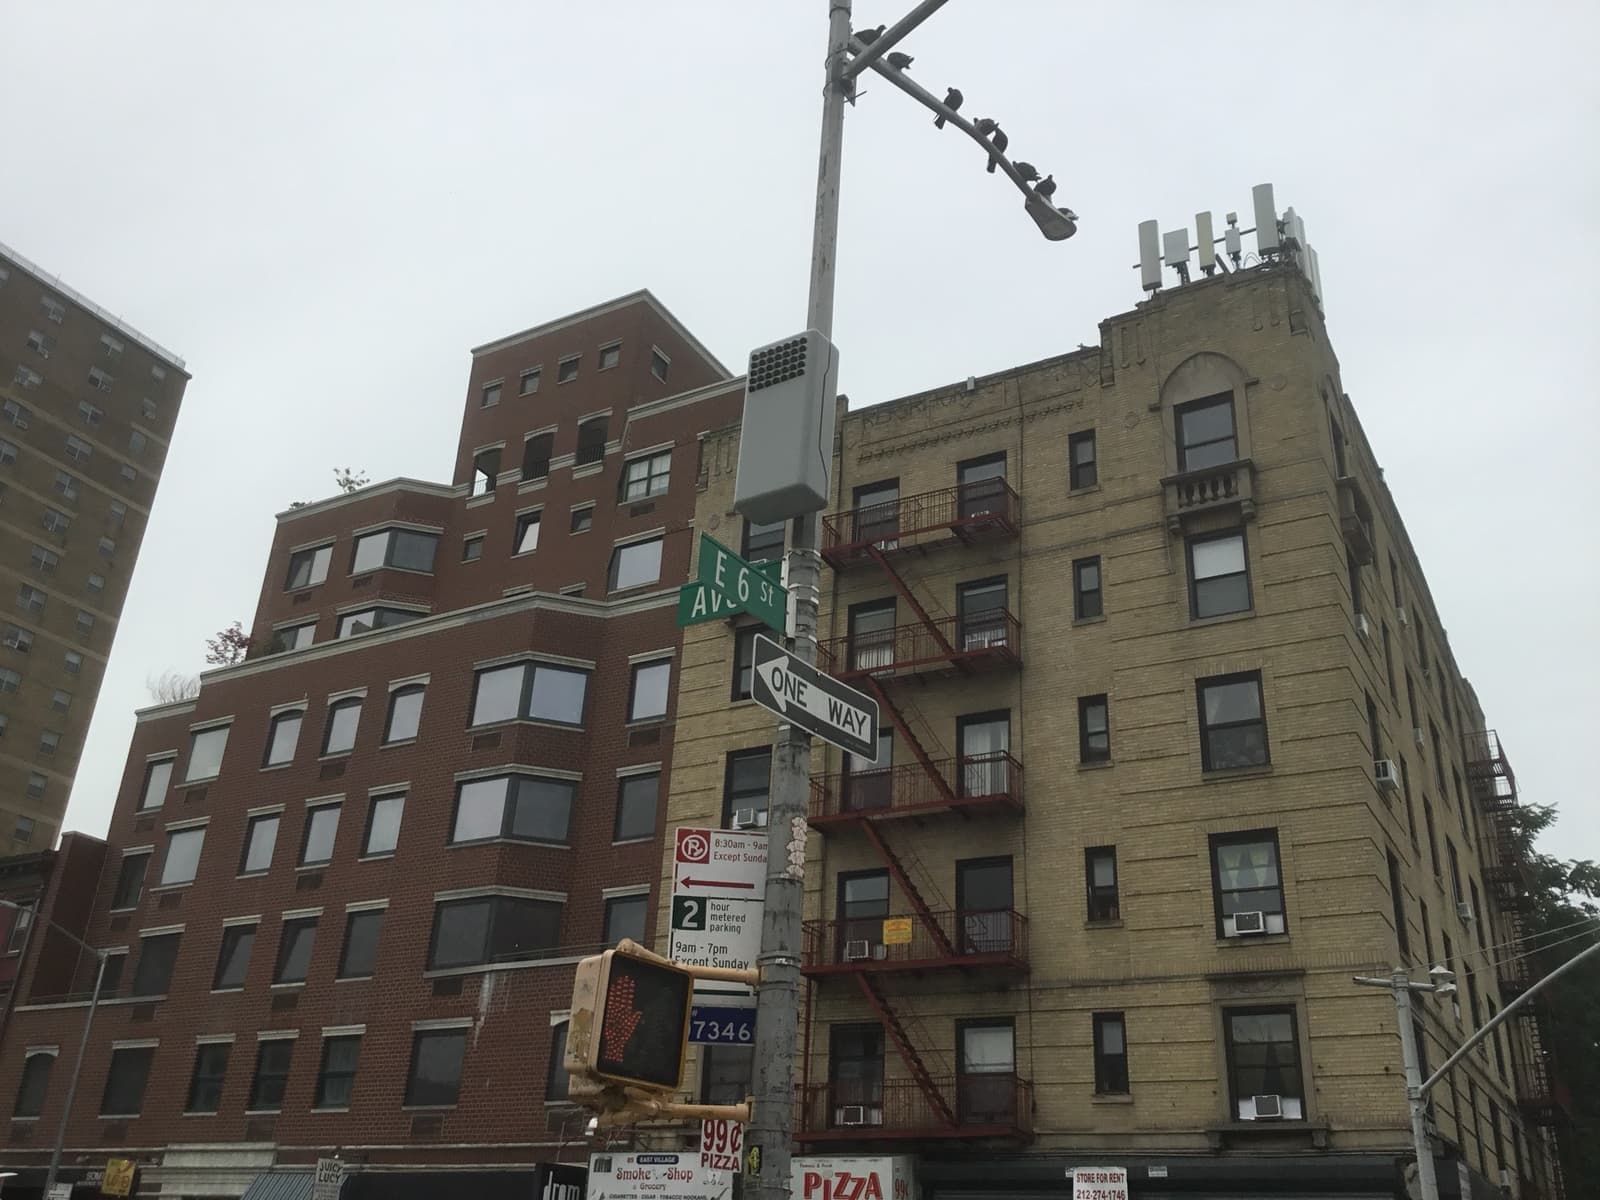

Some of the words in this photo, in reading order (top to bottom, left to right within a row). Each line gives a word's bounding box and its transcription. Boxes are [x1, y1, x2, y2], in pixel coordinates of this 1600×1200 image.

[715, 550, 727, 588] E
[738, 568, 749, 602] 6
[760, 581, 774, 607] St
[771, 666, 807, 708] ONE
[829, 697, 867, 737] WAY
[714, 838, 745, 849] 8:30am
[713, 851, 741, 863] Except
[743, 853, 768, 863] Sunda
[710, 902, 730, 912] hour
[681, 900, 699, 928] 2
[710, 913, 746, 922] metered
[709, 923, 742, 935] parking
[675, 941, 697, 953] 9am
[707, 943, 728, 956] 7pm
[712, 957, 750, 970] Sunday
[319, 1161, 344, 1173] JUICY
[701, 1152, 740, 1172] PIZZA
[318, 1172, 342, 1184] LUCY
[616, 1167, 651, 1180] Smoke
[667, 1167, 694, 1183] Shop
[1076, 1173, 1095, 1184] STORE
[1096, 1173, 1108, 1184] FOR
[1109, 1173, 1125, 1184] RENT
